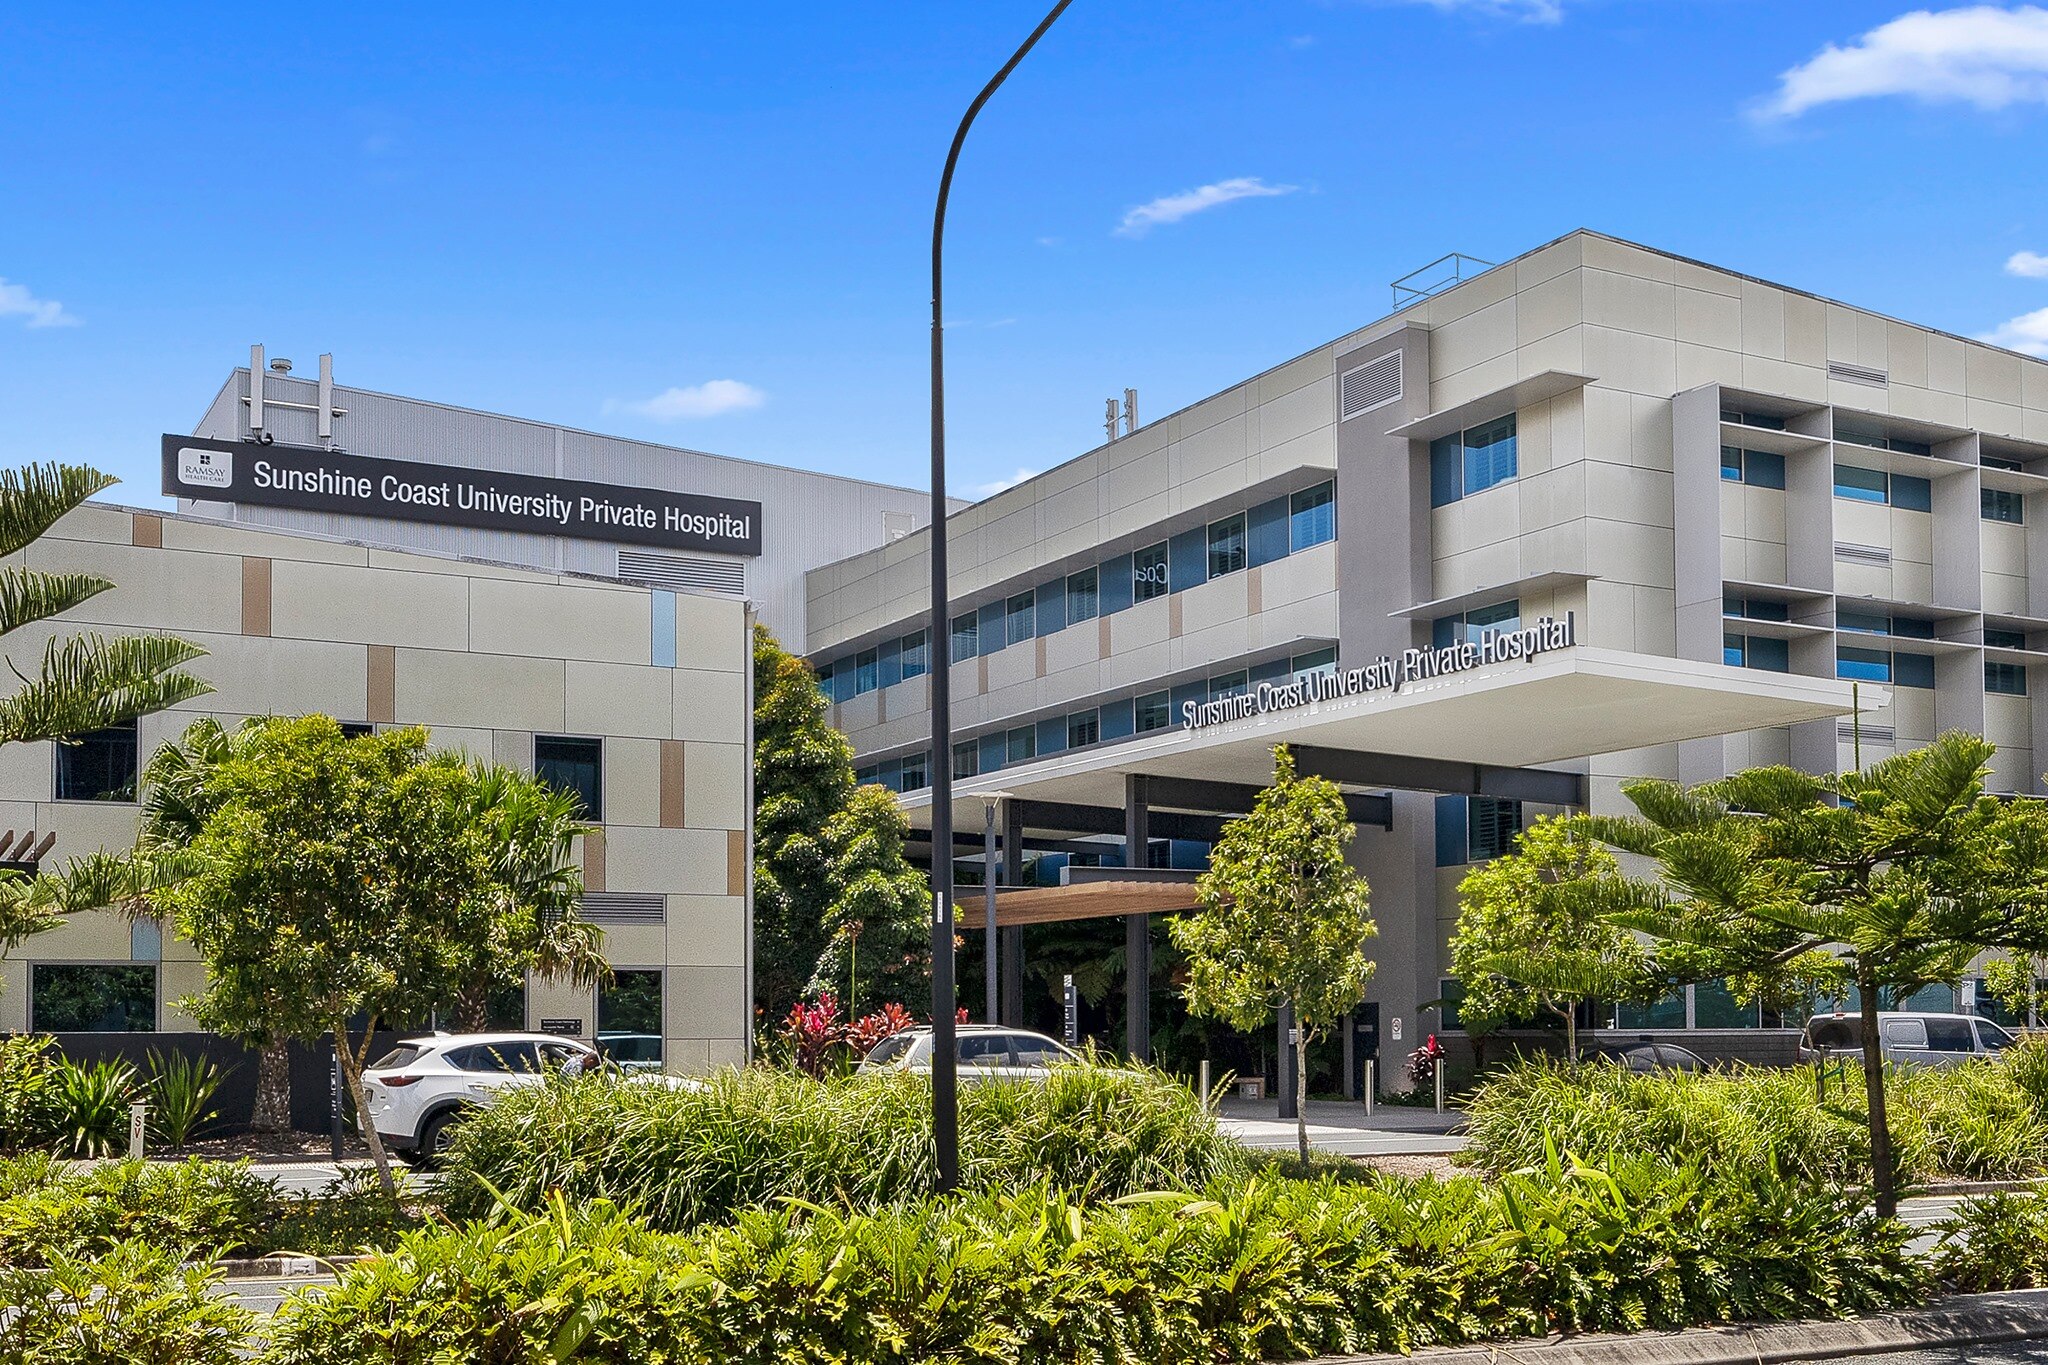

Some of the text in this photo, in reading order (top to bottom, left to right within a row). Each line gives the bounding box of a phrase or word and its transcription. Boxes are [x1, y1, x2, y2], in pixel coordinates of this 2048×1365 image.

[185, 465, 226, 477] RAMSAY
[254, 461, 750, 540] Sunshine Coast University Private Hospital
[1182, 611, 1574, 730] Sunshine Coast University Private Hospital
